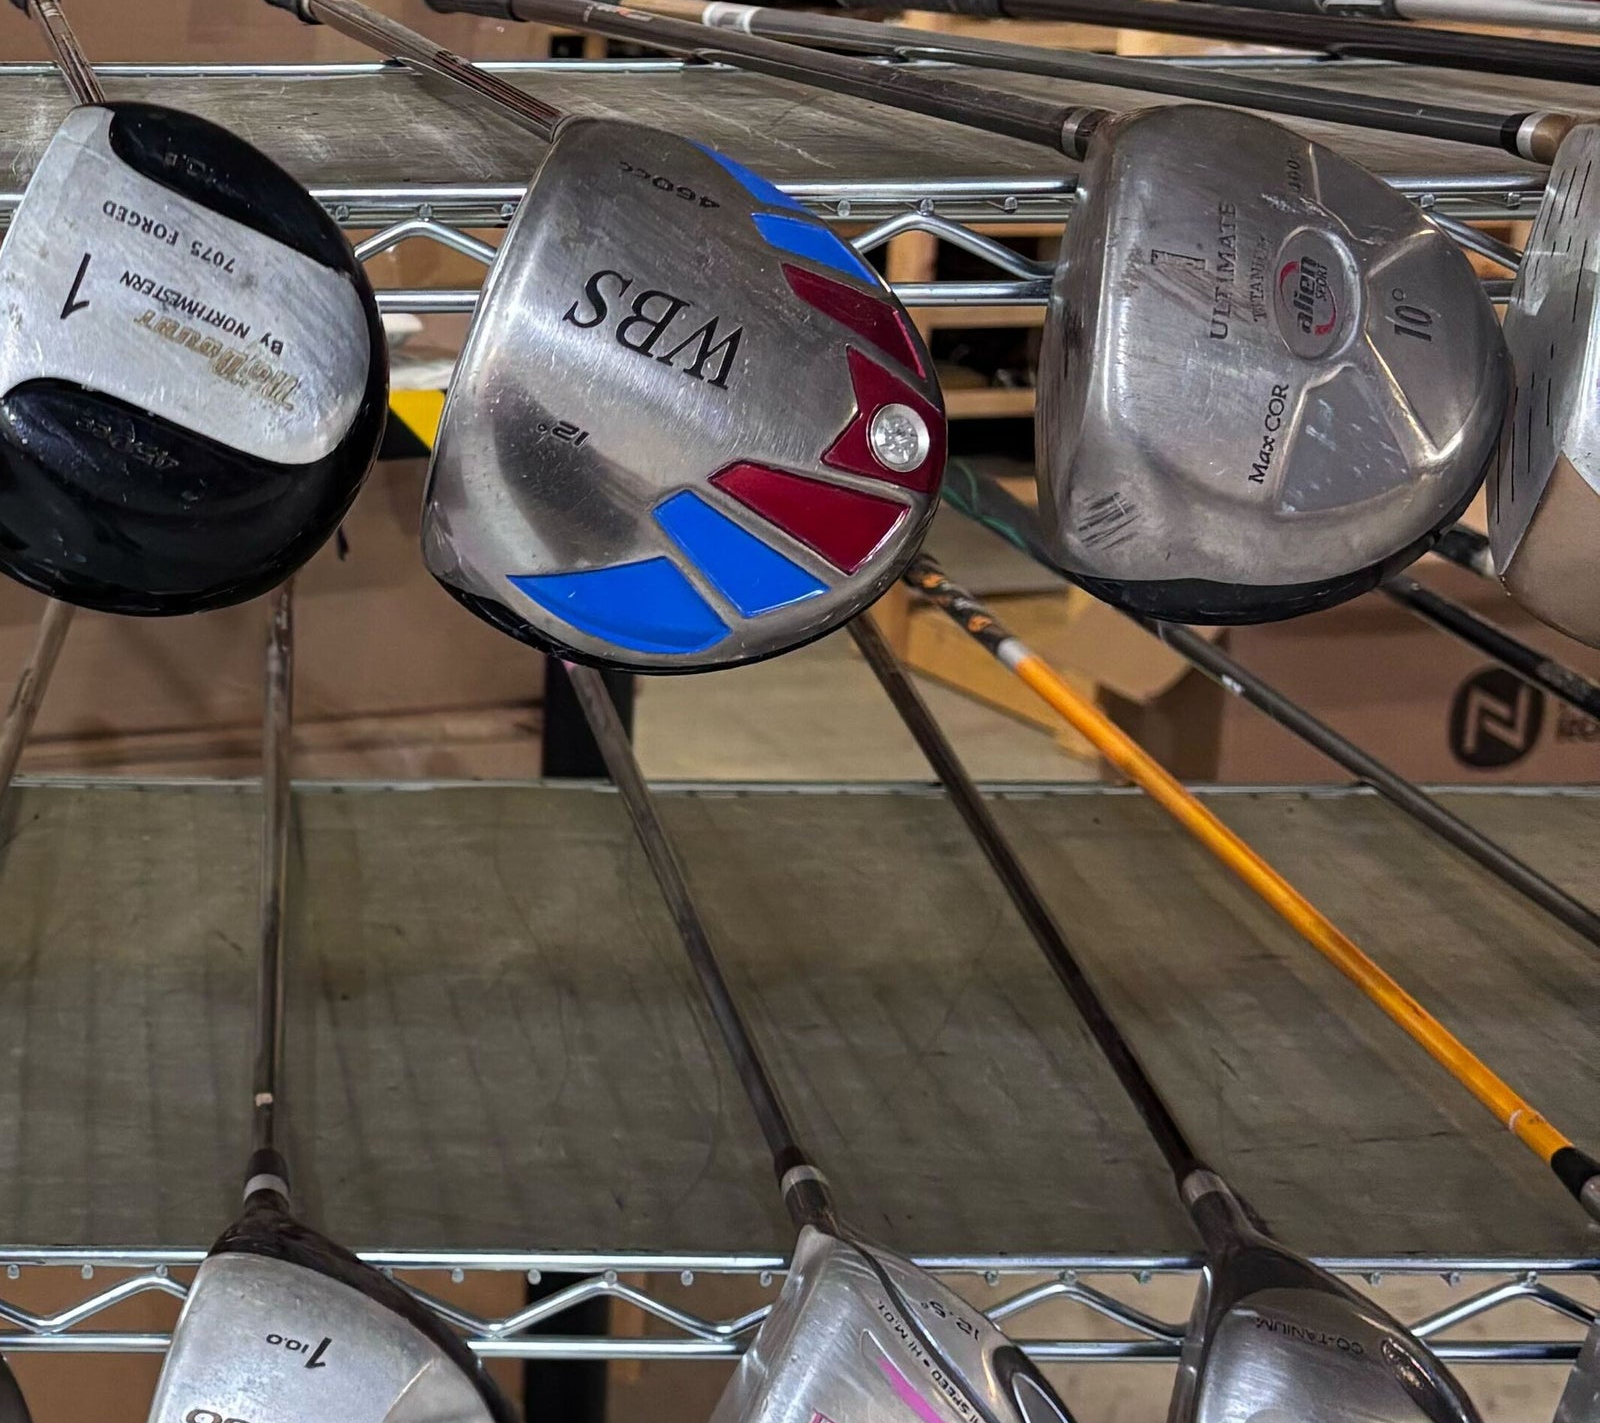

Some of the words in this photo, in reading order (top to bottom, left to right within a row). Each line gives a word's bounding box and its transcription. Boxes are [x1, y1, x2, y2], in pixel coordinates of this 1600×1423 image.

[618, 161, 721, 210] 460cc
[102, 200, 180, 247] FORGED
[191, 240, 236, 275] 7075
[1209, 201, 1241, 341] ULTIMATE
[1252, 235, 1273, 323] TITANIUM
[1314, 262, 1328, 302] SPORT
[61, 253, 91, 320] 1
[120, 269, 250, 340] NORTHWESTERN
[1293, 256, 1320, 336] alien
[260, 329, 284, 357] By
[562, 268, 746, 390] WBS
[267, 1333, 312, 1354] 10.0
[304, 1336, 333, 1370] 1
[907, 1336, 926, 1359] HI
[930, 1369, 971, 1418] SPEED
